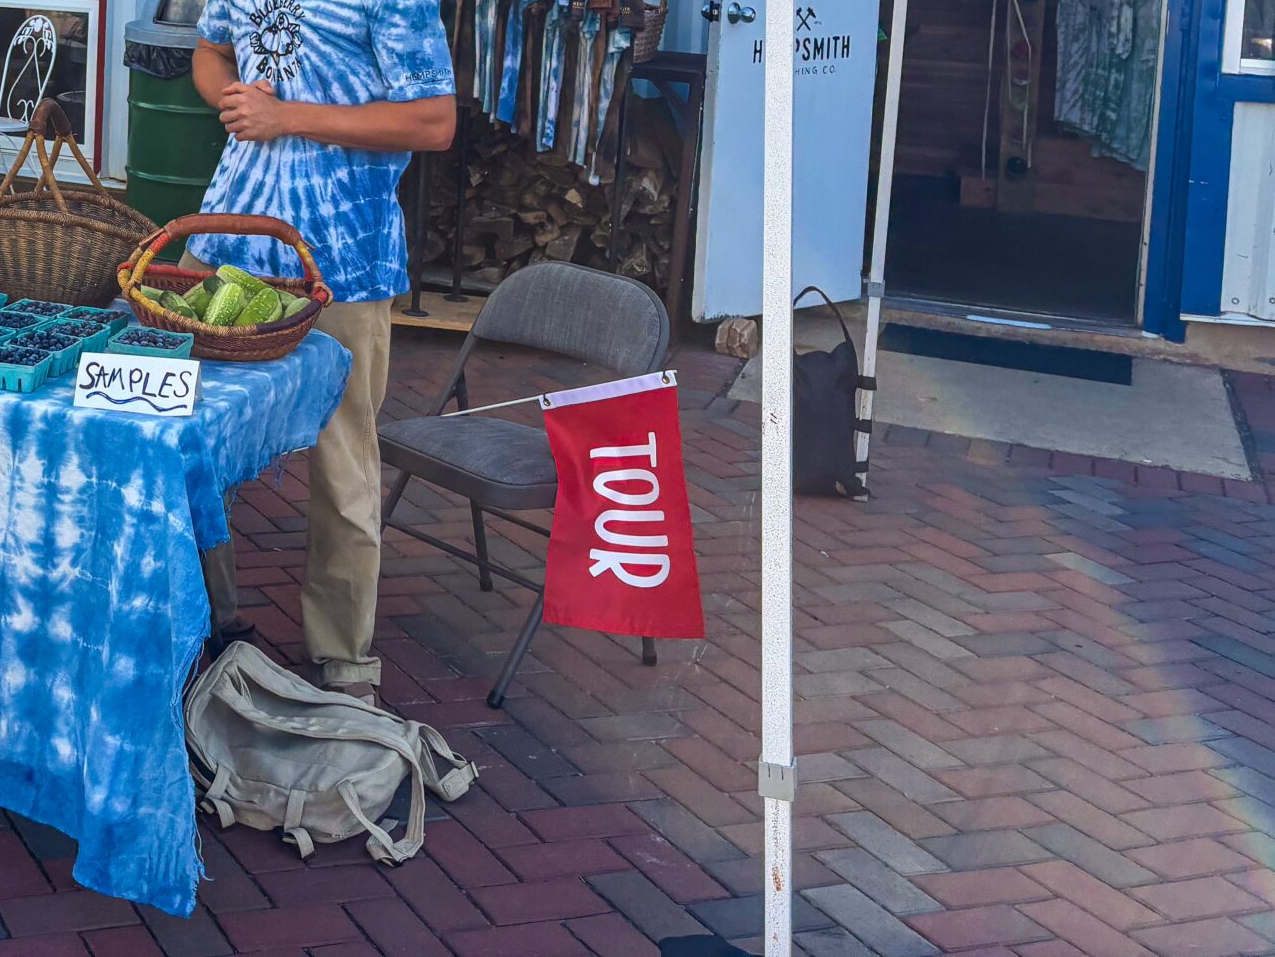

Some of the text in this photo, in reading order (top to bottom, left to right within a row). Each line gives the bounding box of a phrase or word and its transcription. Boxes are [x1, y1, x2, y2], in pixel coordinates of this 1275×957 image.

[753, 35, 851, 64] HSMITH
[79, 362, 192, 398] SAMPLES
[589, 432, 671, 588] TOUR
